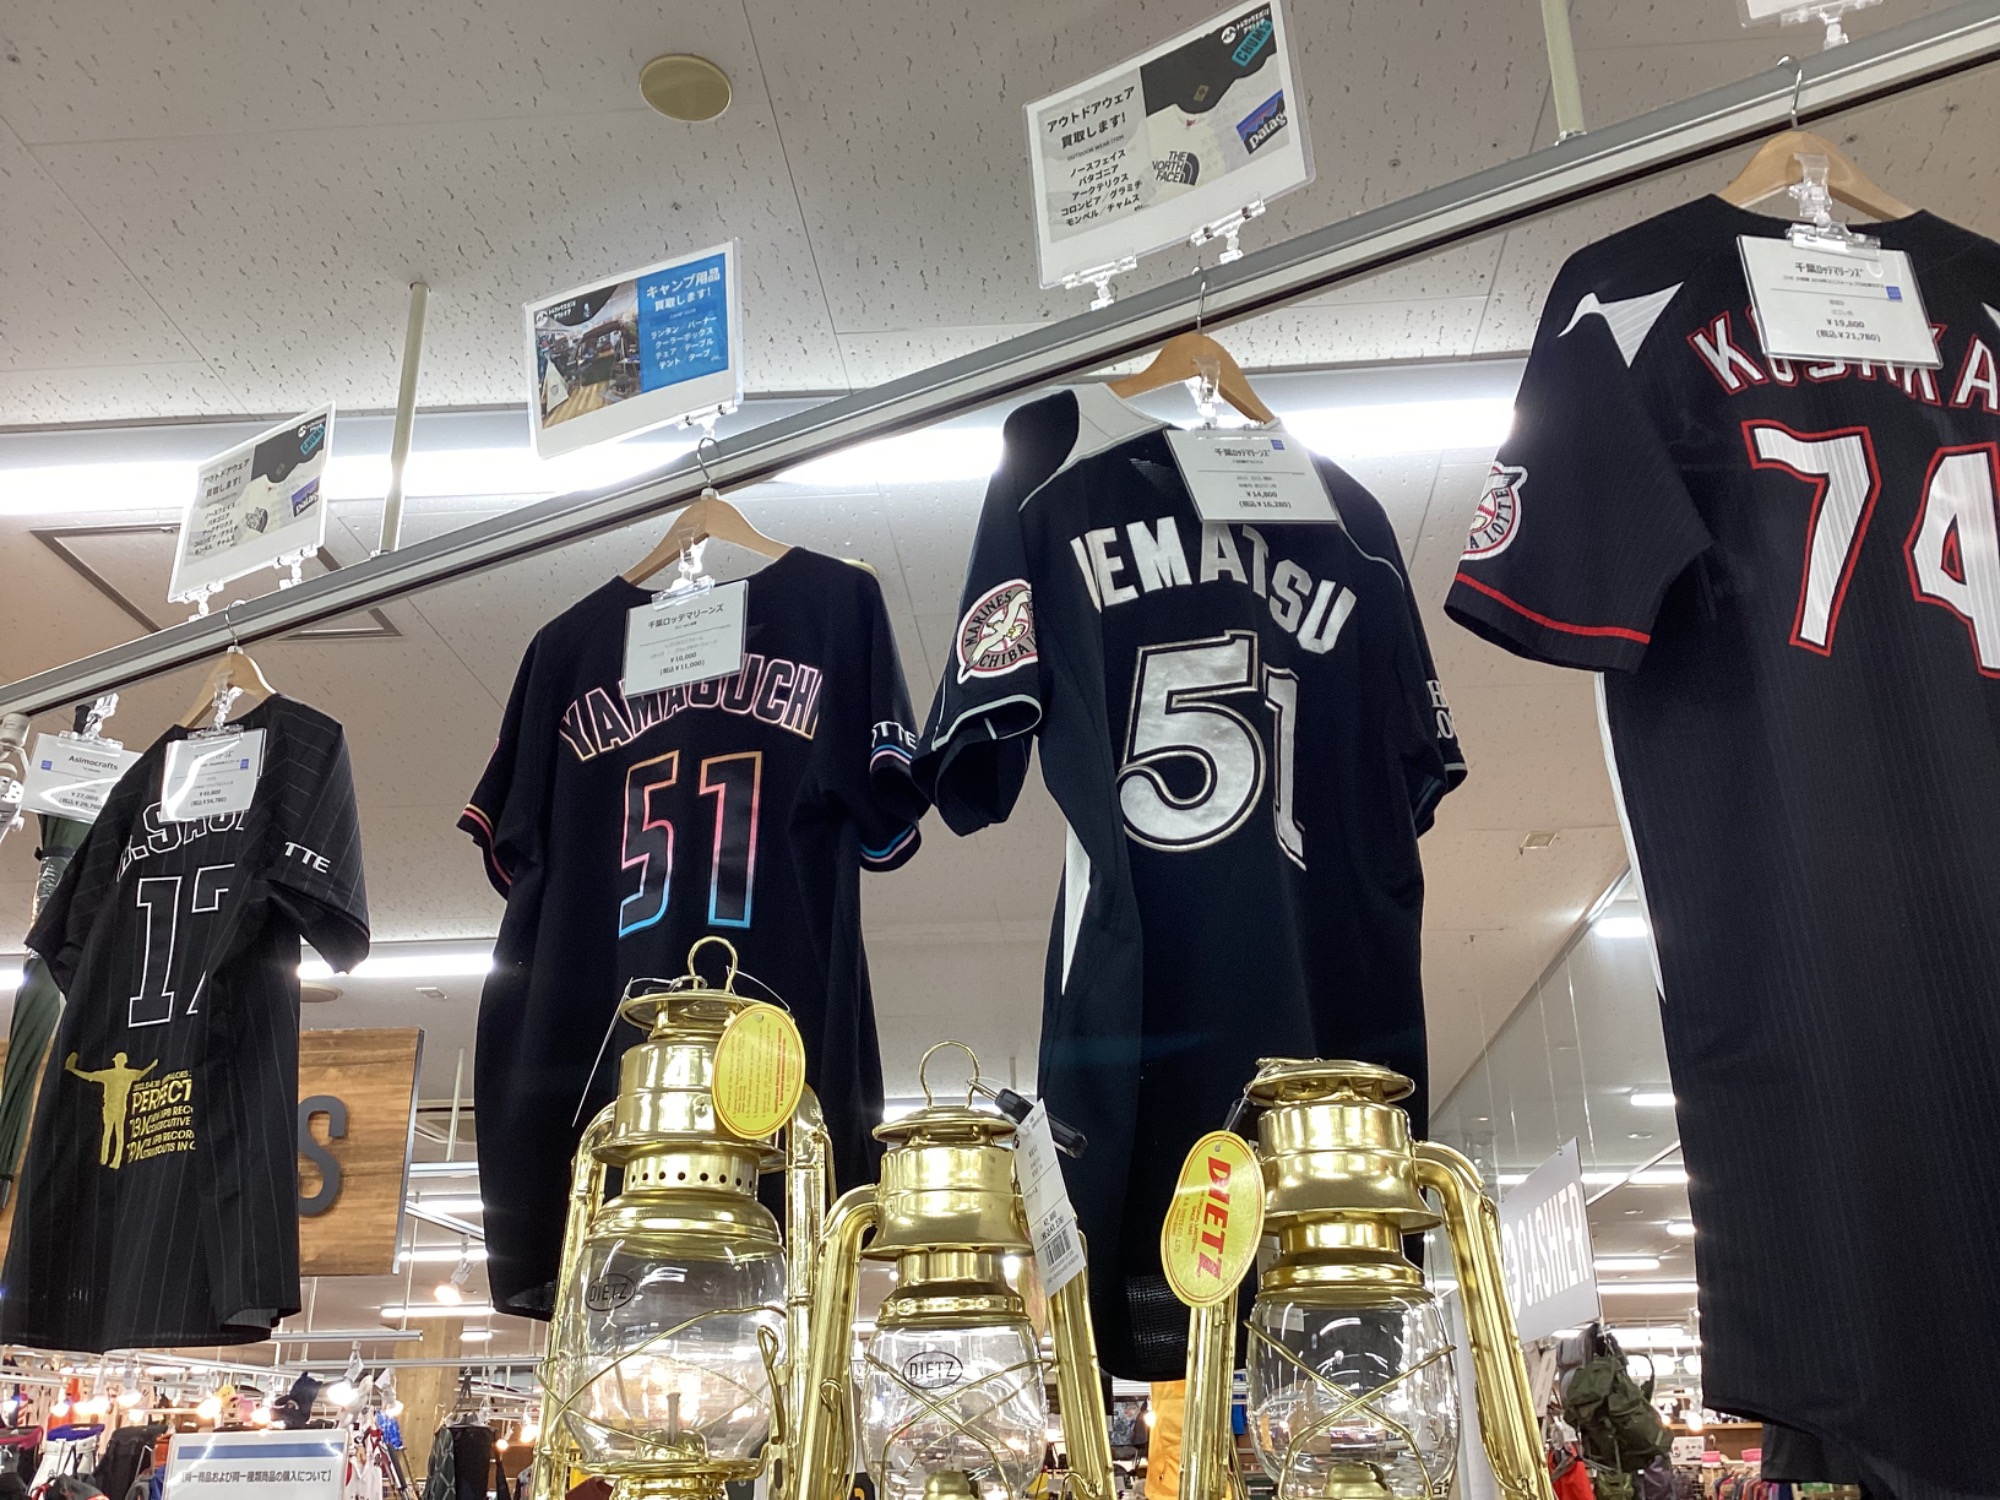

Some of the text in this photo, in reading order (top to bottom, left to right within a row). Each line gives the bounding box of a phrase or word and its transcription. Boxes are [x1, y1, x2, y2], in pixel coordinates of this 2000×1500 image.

[1236, 20, 1272, 63] CHUMS
[1047, 86, 1135, 133] アウトドアウェア
[1061, 112, 1126, 149] 買取します!
[1067, 147, 1094, 161] OUTDOOR
[1095, 140, 1110, 152] WEAR
[1070, 149, 1126, 178] ノースフェイス
[1169, 151, 1187, 161] THE
[1072, 173, 1129, 201] アークテリクス
[1078, 164, 1119, 187] パタゴニア
[1156, 170, 1180, 183] FACE
[646, 267, 721, 299] キャンプ用品
[655, 287, 711, 312] 買取します!
[651, 316, 718, 340] ランタン バーナー
[655, 327, 714, 349] クーラーボックス
[655, 338, 714, 360] チェア テーブル
[659, 357, 681, 370] テント
[688, 348, 711, 362] タープ
[1484, 489, 1512, 544] LOTTE
[1742, 420, 2000, 678] 74
[648, 603, 724, 630] 千葉ロッテマリーンズ
[965, 590, 1012, 648] MARINES
[979, 643, 1030, 669] CHIBA
[69, 755, 119, 770] Asimocrafts
[1117, 629, 1307, 871] 51
[619, 750, 763, 938] 51
[1197, 1156, 1231, 1279] DIETZ
[1518, 1182, 1589, 1307] CASHIER
[589, 1282, 627, 1302] DIETZ
[909, 1361, 955, 1379] DIETZ
